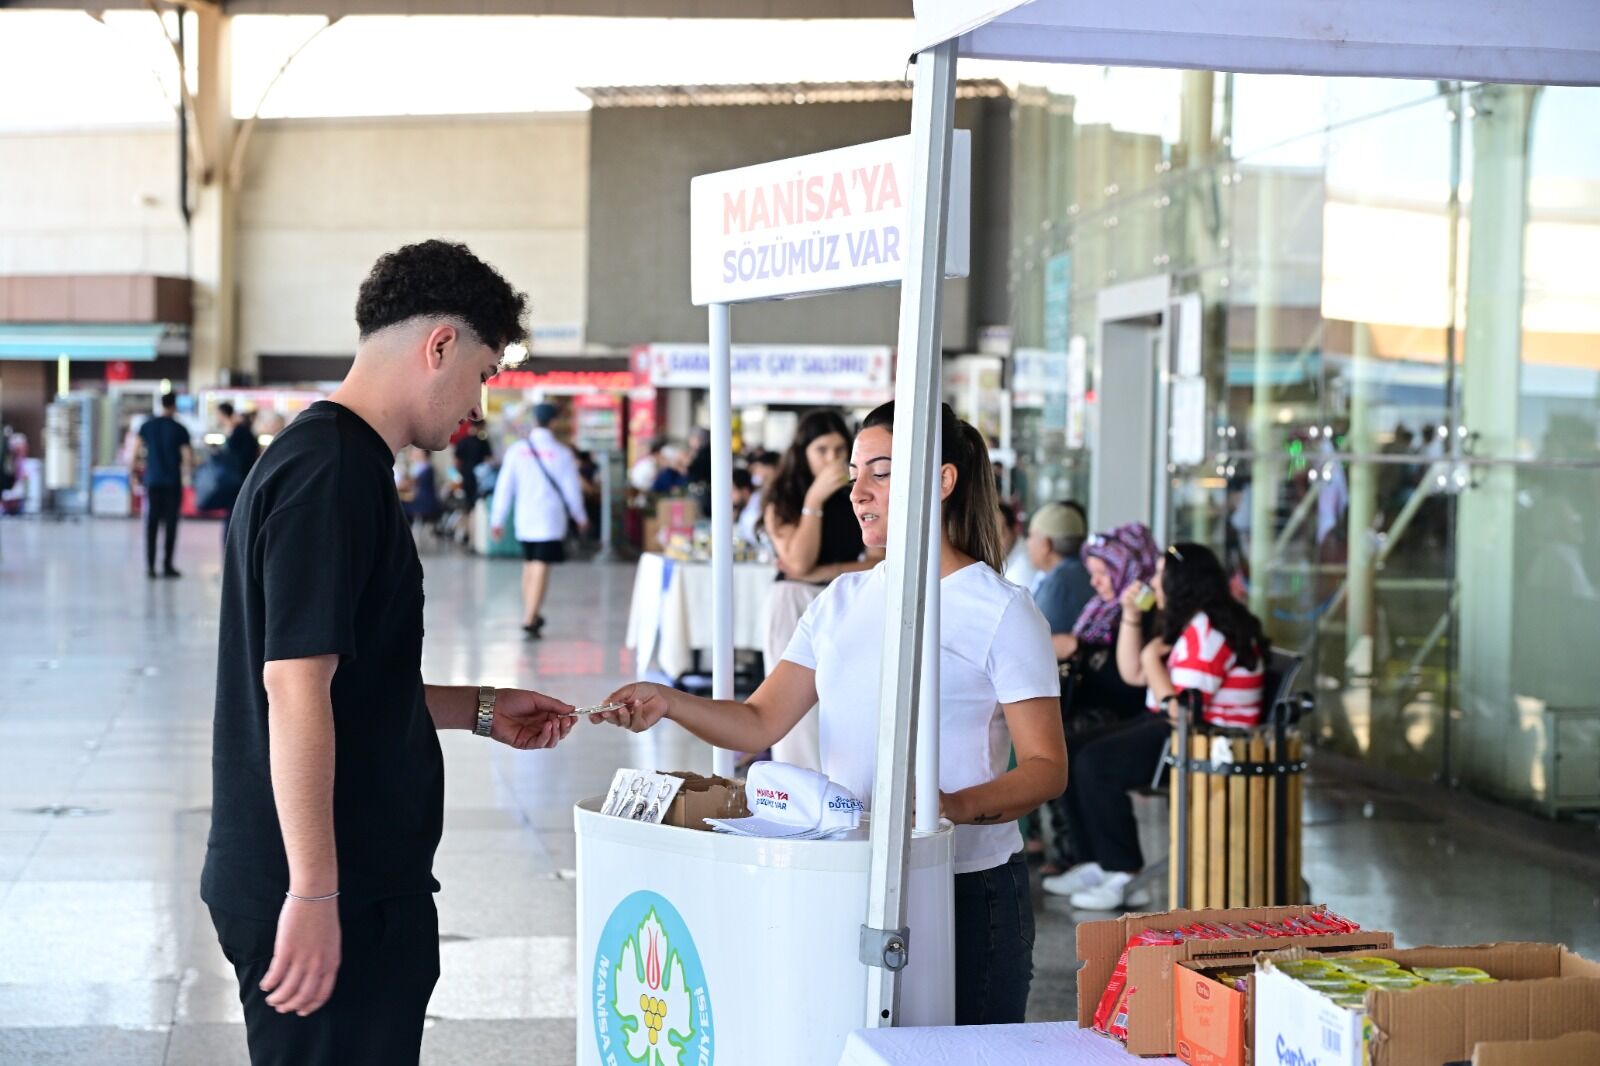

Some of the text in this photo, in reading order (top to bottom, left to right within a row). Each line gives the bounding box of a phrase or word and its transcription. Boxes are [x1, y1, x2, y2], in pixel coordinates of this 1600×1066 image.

[722, 162, 902, 236] MANİSA'YA
[722, 225, 901, 284] SÖZÜMÜZ VAR
[597, 954, 611, 1052] MANİSA
